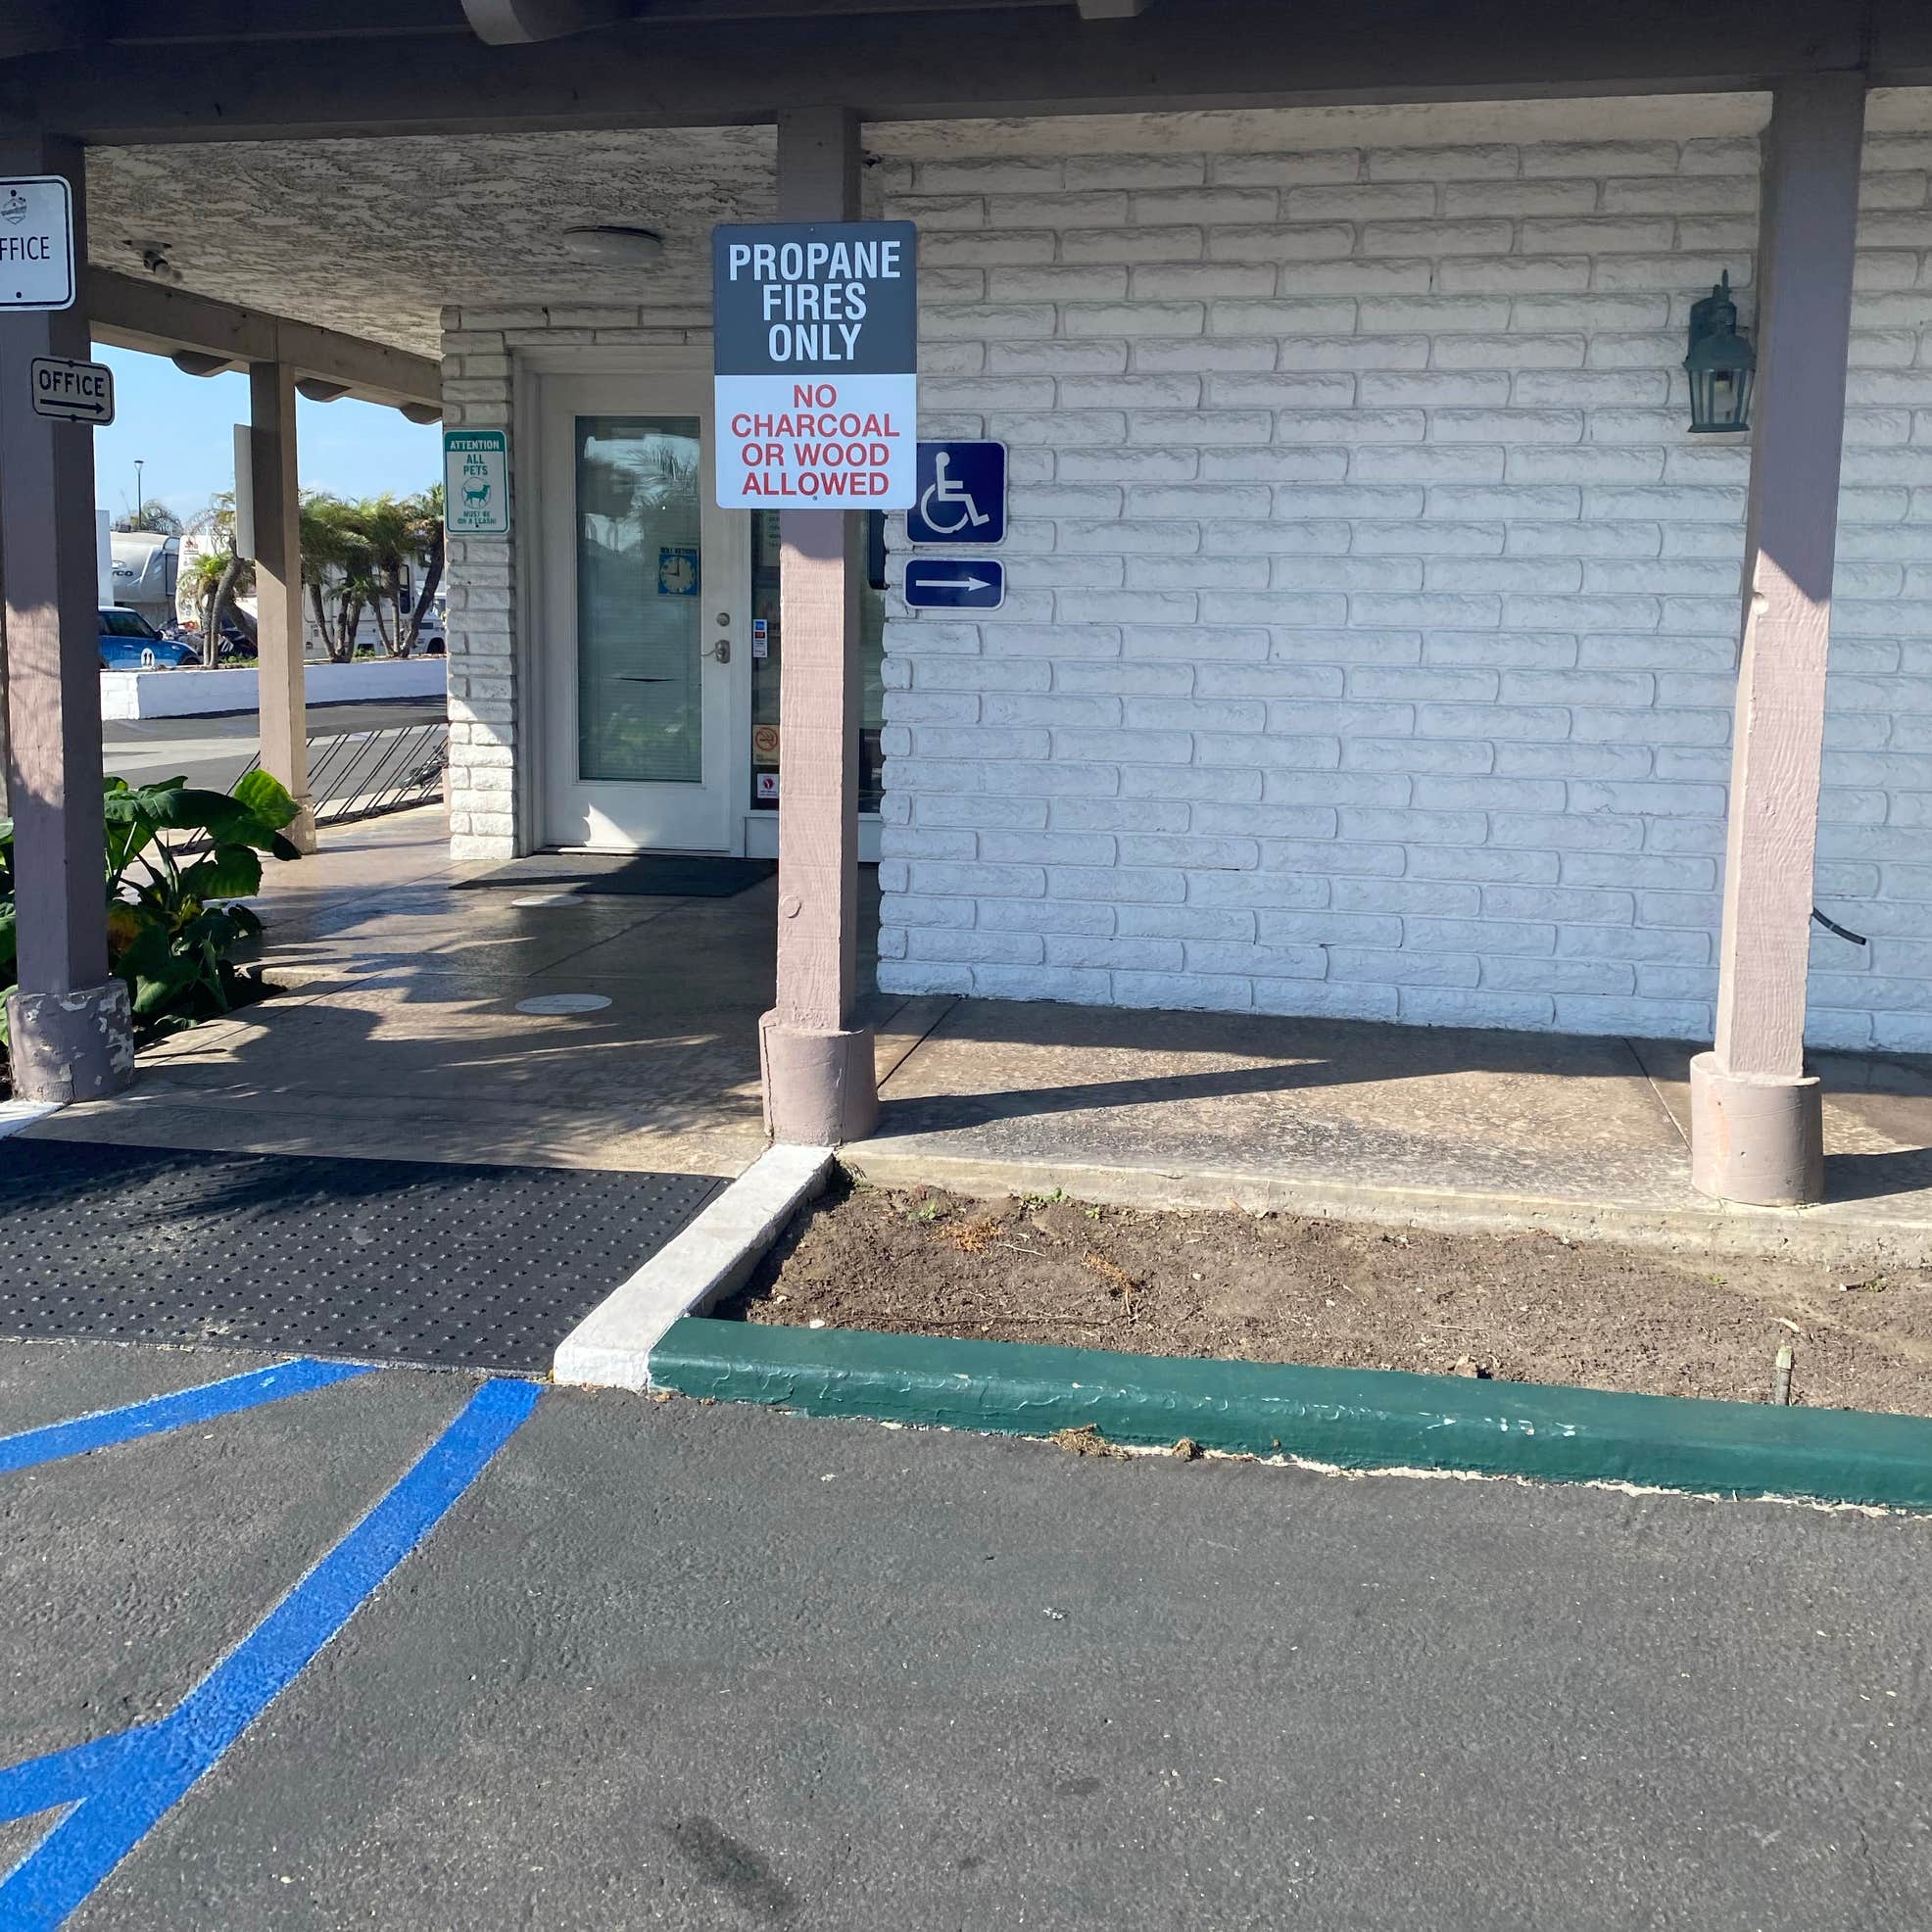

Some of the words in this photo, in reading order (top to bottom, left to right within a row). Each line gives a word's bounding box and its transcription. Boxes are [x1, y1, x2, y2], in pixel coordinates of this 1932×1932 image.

[0, 236, 50, 261] FFICE
[729, 241, 901, 281] PROPANE
[763, 282, 867, 321] FIRES
[768, 323, 862, 362] ONLY
[39, 369, 105, 398] OFFICE
[794, 384, 837, 408] NO
[731, 413, 900, 438] CHARCOAL
[450, 439, 500, 451] ATTENTION
[742, 443, 784, 466] OR
[795, 443, 890, 466] WOOD
[463, 464, 488, 476] PETS
[466, 454, 485, 464] ALL
[742, 472, 890, 496] ALLOWED
